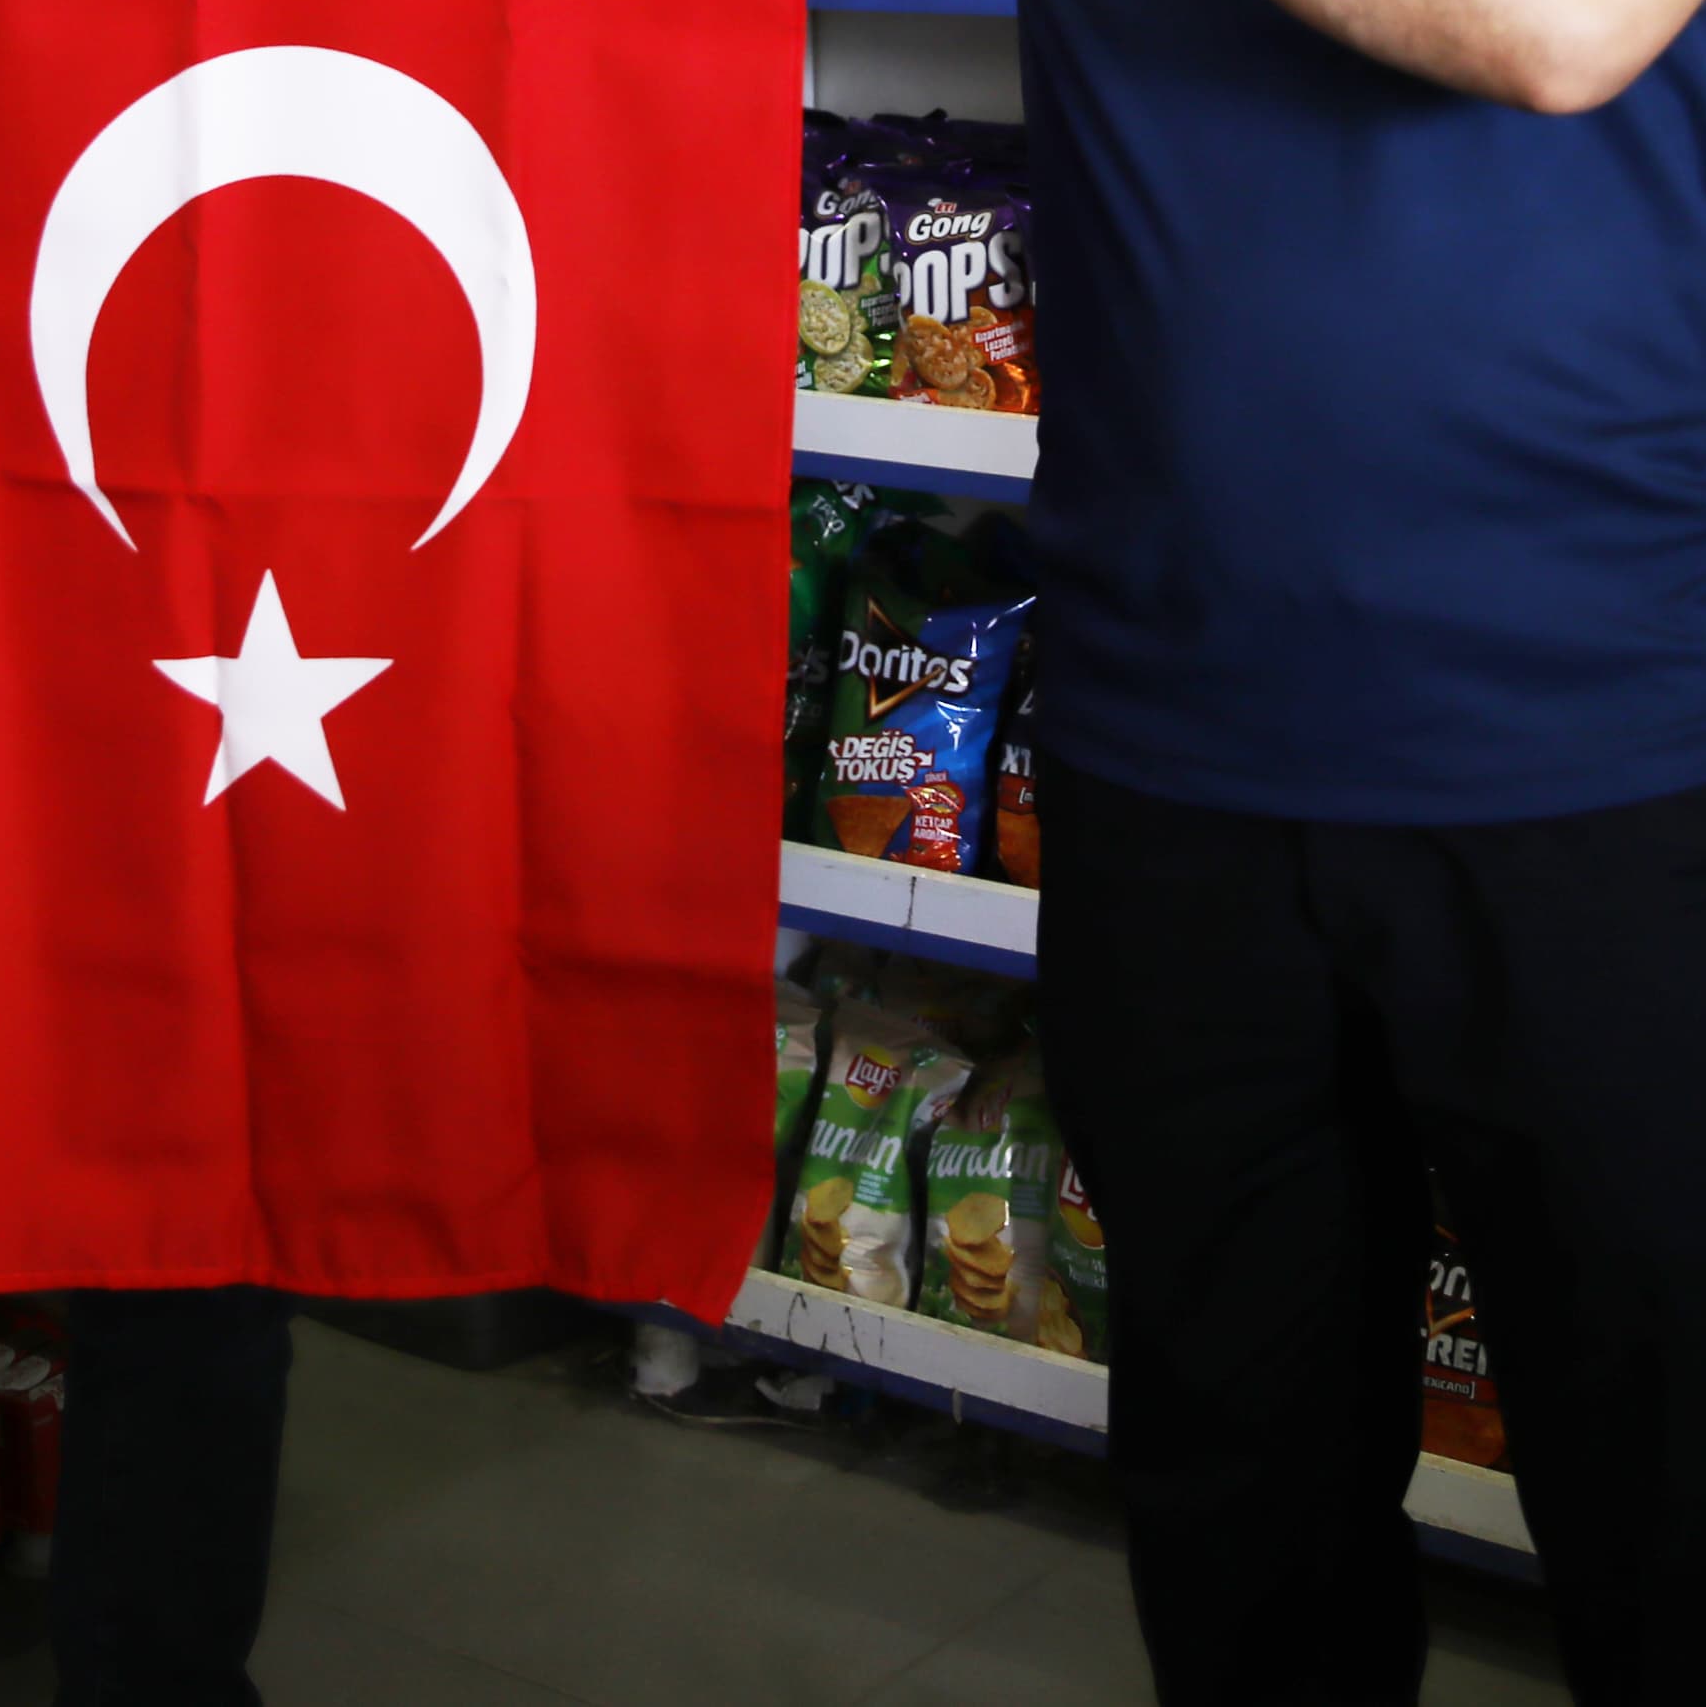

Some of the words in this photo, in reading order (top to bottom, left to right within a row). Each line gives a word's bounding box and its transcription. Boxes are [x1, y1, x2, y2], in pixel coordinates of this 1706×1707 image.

[908, 211, 993, 244] Gong
[839, 630, 974, 696] Doritos
[841, 730, 917, 761] DEĞİŞ
[835, 757, 918, 788] TOKUŞ
[848, 1054, 899, 1105] Lay's
